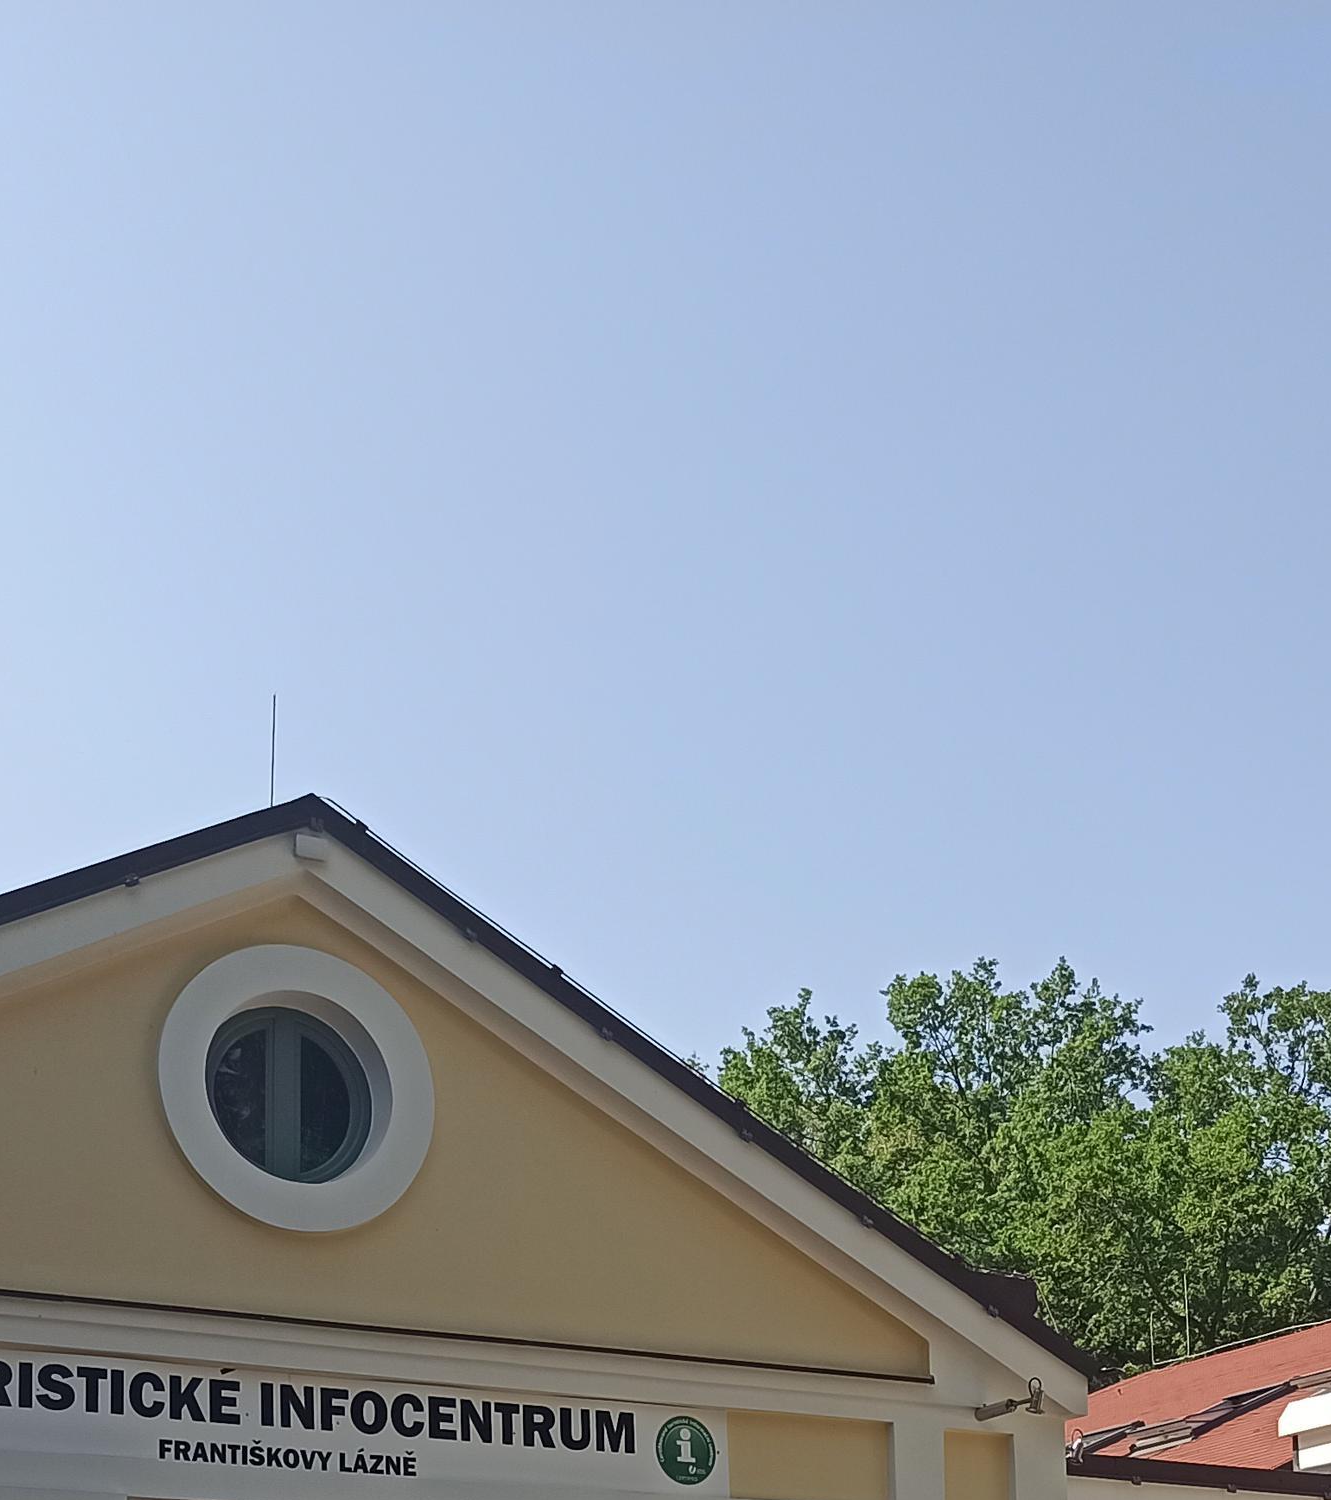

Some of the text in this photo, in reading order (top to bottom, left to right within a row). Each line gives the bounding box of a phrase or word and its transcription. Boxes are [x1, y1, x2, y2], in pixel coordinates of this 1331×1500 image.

[260, 1382, 635, 1454] INFOCENTRUM
[158, 1438, 417, 1477] FRANTIŠKOVY LÁZNĚ
